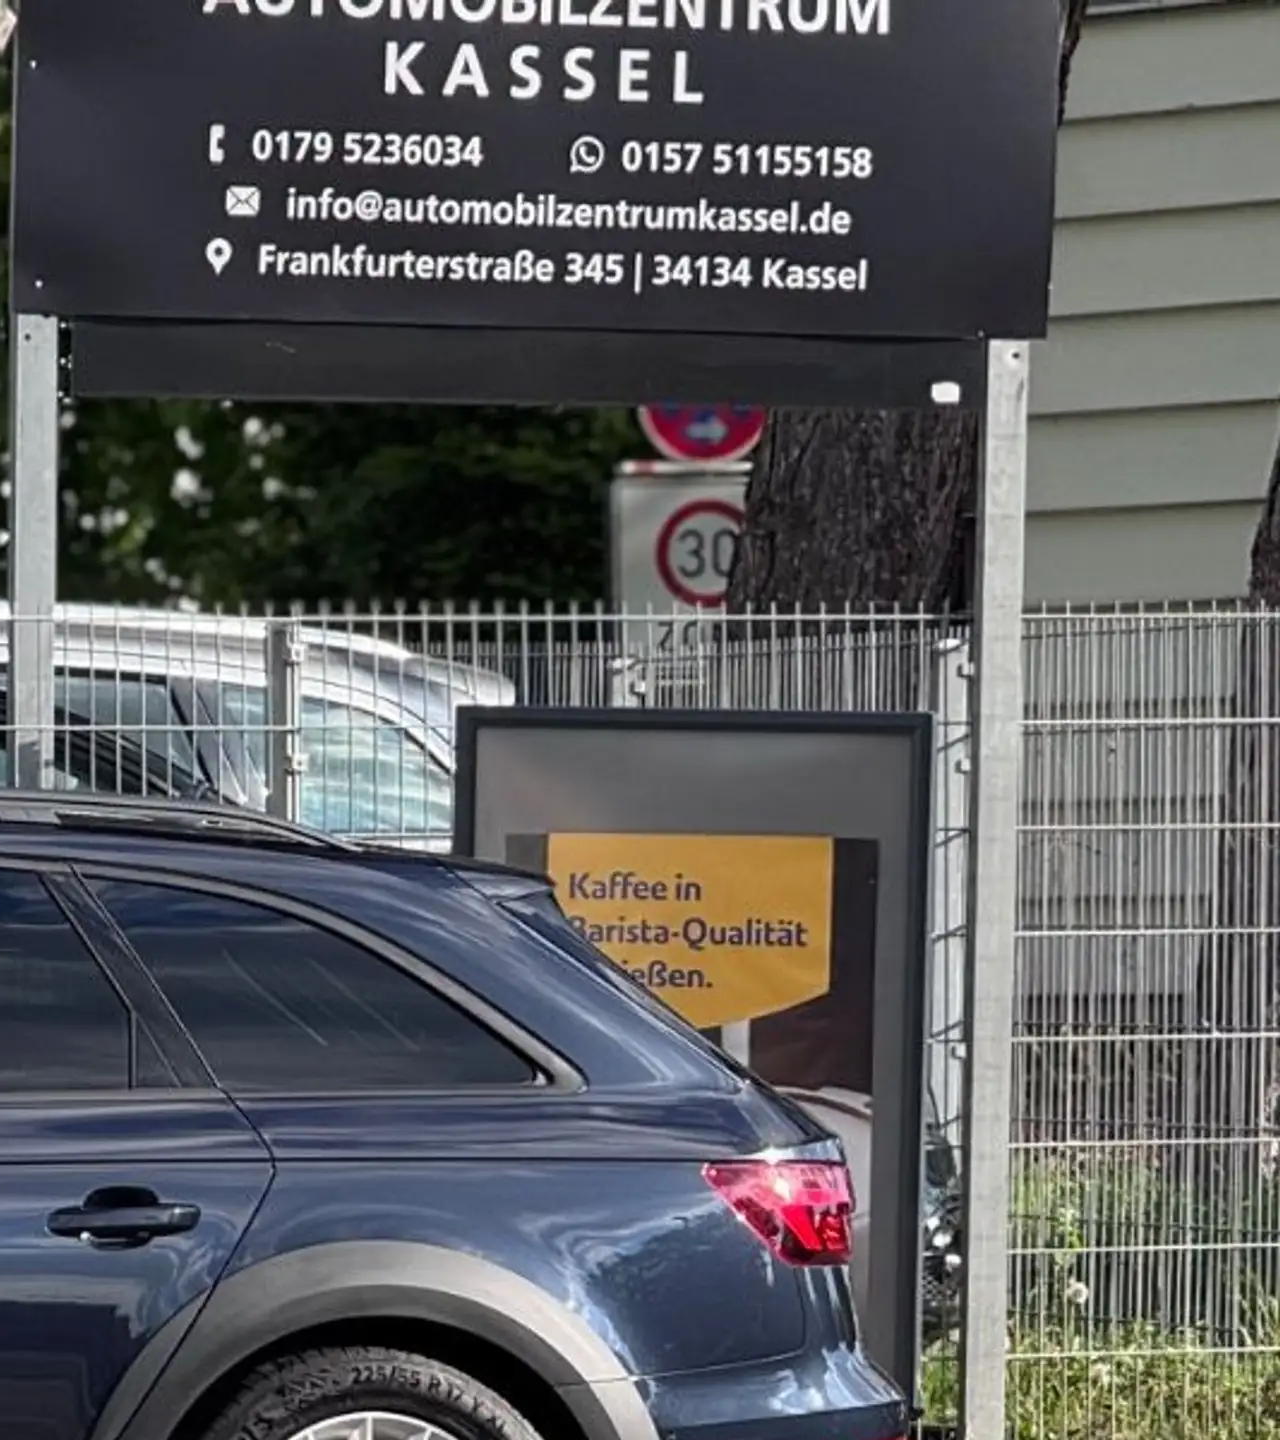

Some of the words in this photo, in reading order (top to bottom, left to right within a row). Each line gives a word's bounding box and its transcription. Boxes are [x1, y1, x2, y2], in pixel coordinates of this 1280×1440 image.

[202, 0, 890, 35] LZENTRUM
[384, 40, 704, 104] KASSEL
[252, 129, 334, 162] 0179
[343, 132, 484, 168] 5236034
[621, 140, 703, 174] 0157
[712, 143, 873, 179] 51155158
[286, 186, 852, 235] info@automobilzentrumkassel.de
[258, 243, 555, 283] Frankfurterstraße
[564, 252, 624, 284] 345
[651, 254, 753, 288] 34134
[762, 257, 868, 291] Kassel
[676, 528, 737, 579] 30
[568, 871, 669, 900] Kaffee
[675, 872, 702, 901] in
[350, 1364, 422, 1388] 225/55
